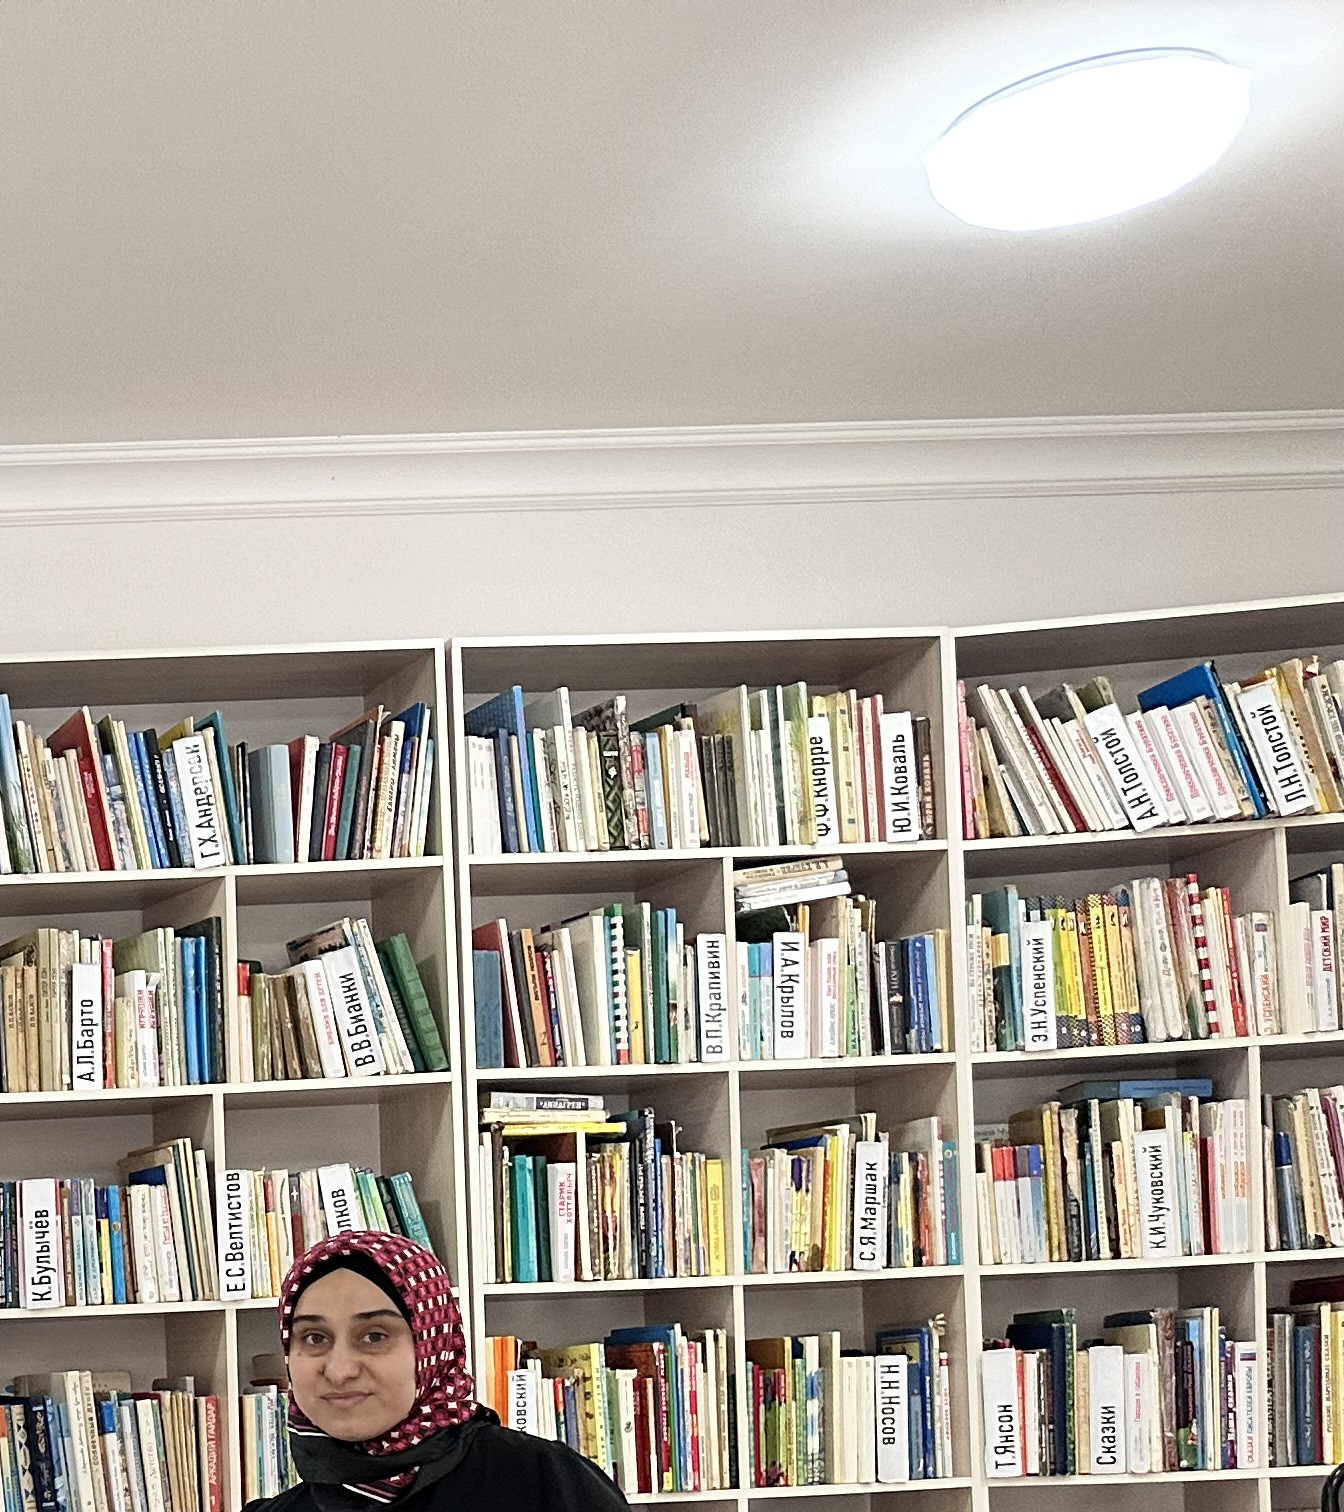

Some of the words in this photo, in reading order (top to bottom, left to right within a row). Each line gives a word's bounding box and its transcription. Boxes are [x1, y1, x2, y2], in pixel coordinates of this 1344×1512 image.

[890, 734, 912, 833] Ю.И.Коваль
[1092, 727, 1159, 821] А.Н.Толстой
[1249, 705, 1307, 802] Л.Н.Толстой
[338, 971, 375, 1067] В.В.Бианки
[706, 939, 724, 1056] В.П.Крапивин
[776, 941, 800, 1038] И.А.Крылов
[1026, 938, 1048, 1042] Э.Н.Успенский
[77, 999, 99, 1082] А.Л.Барто
[224, 1172, 246, 1292] Е.С.Велтистов
[859, 1161, 880, 1261] С.Я.Маршак
[1142, 1145, 1170, 1249] К.И.Чуковский
[29, 1209, 56, 1301] К.Булычёв
[880, 1364, 900, 1445] Н.Н.Носов
[994, 1404, 1016, 1469] Т.Янсон
[1096, 1406, 1117, 1465] Сказки
